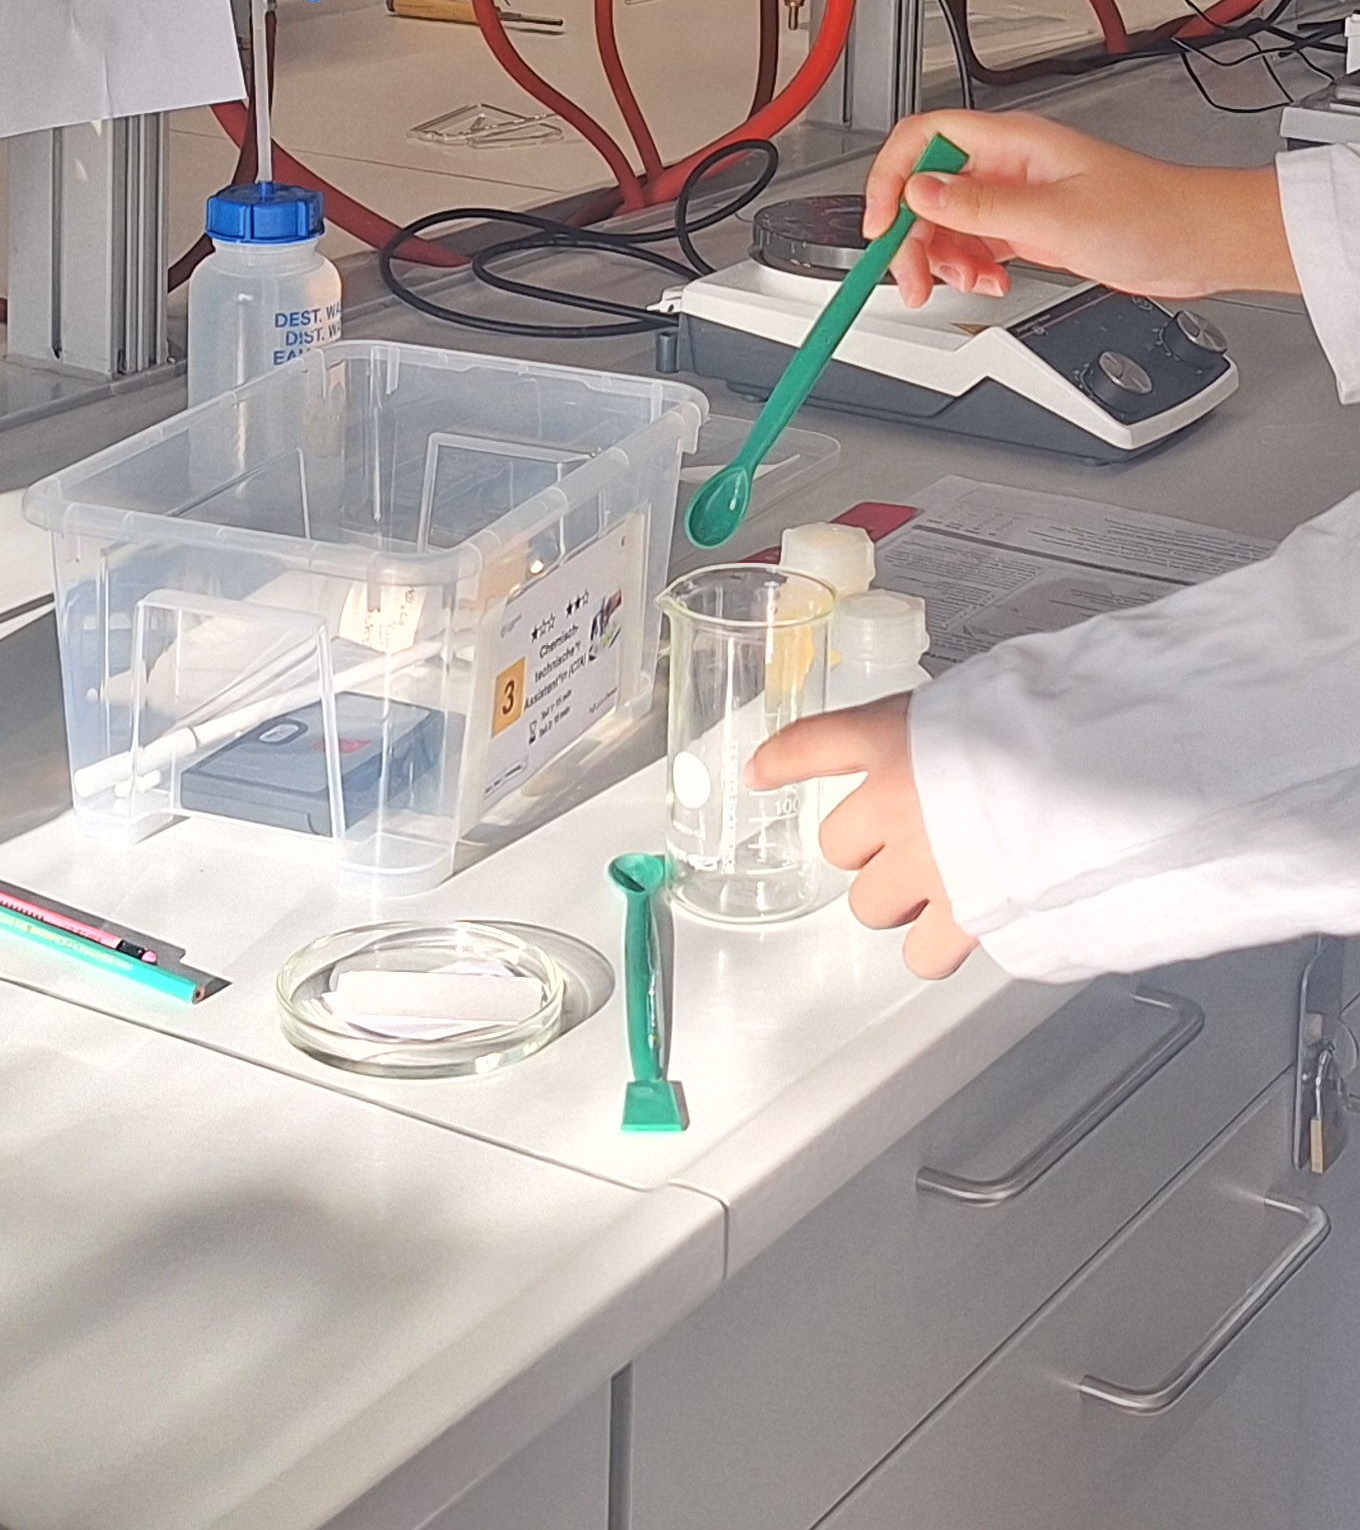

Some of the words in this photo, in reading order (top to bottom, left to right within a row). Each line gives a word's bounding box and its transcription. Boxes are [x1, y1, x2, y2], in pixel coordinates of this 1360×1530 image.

[274, 308, 322, 328] DEST.
[285, 327, 325, 346] DIST.
[502, 678, 515, 715] 3
